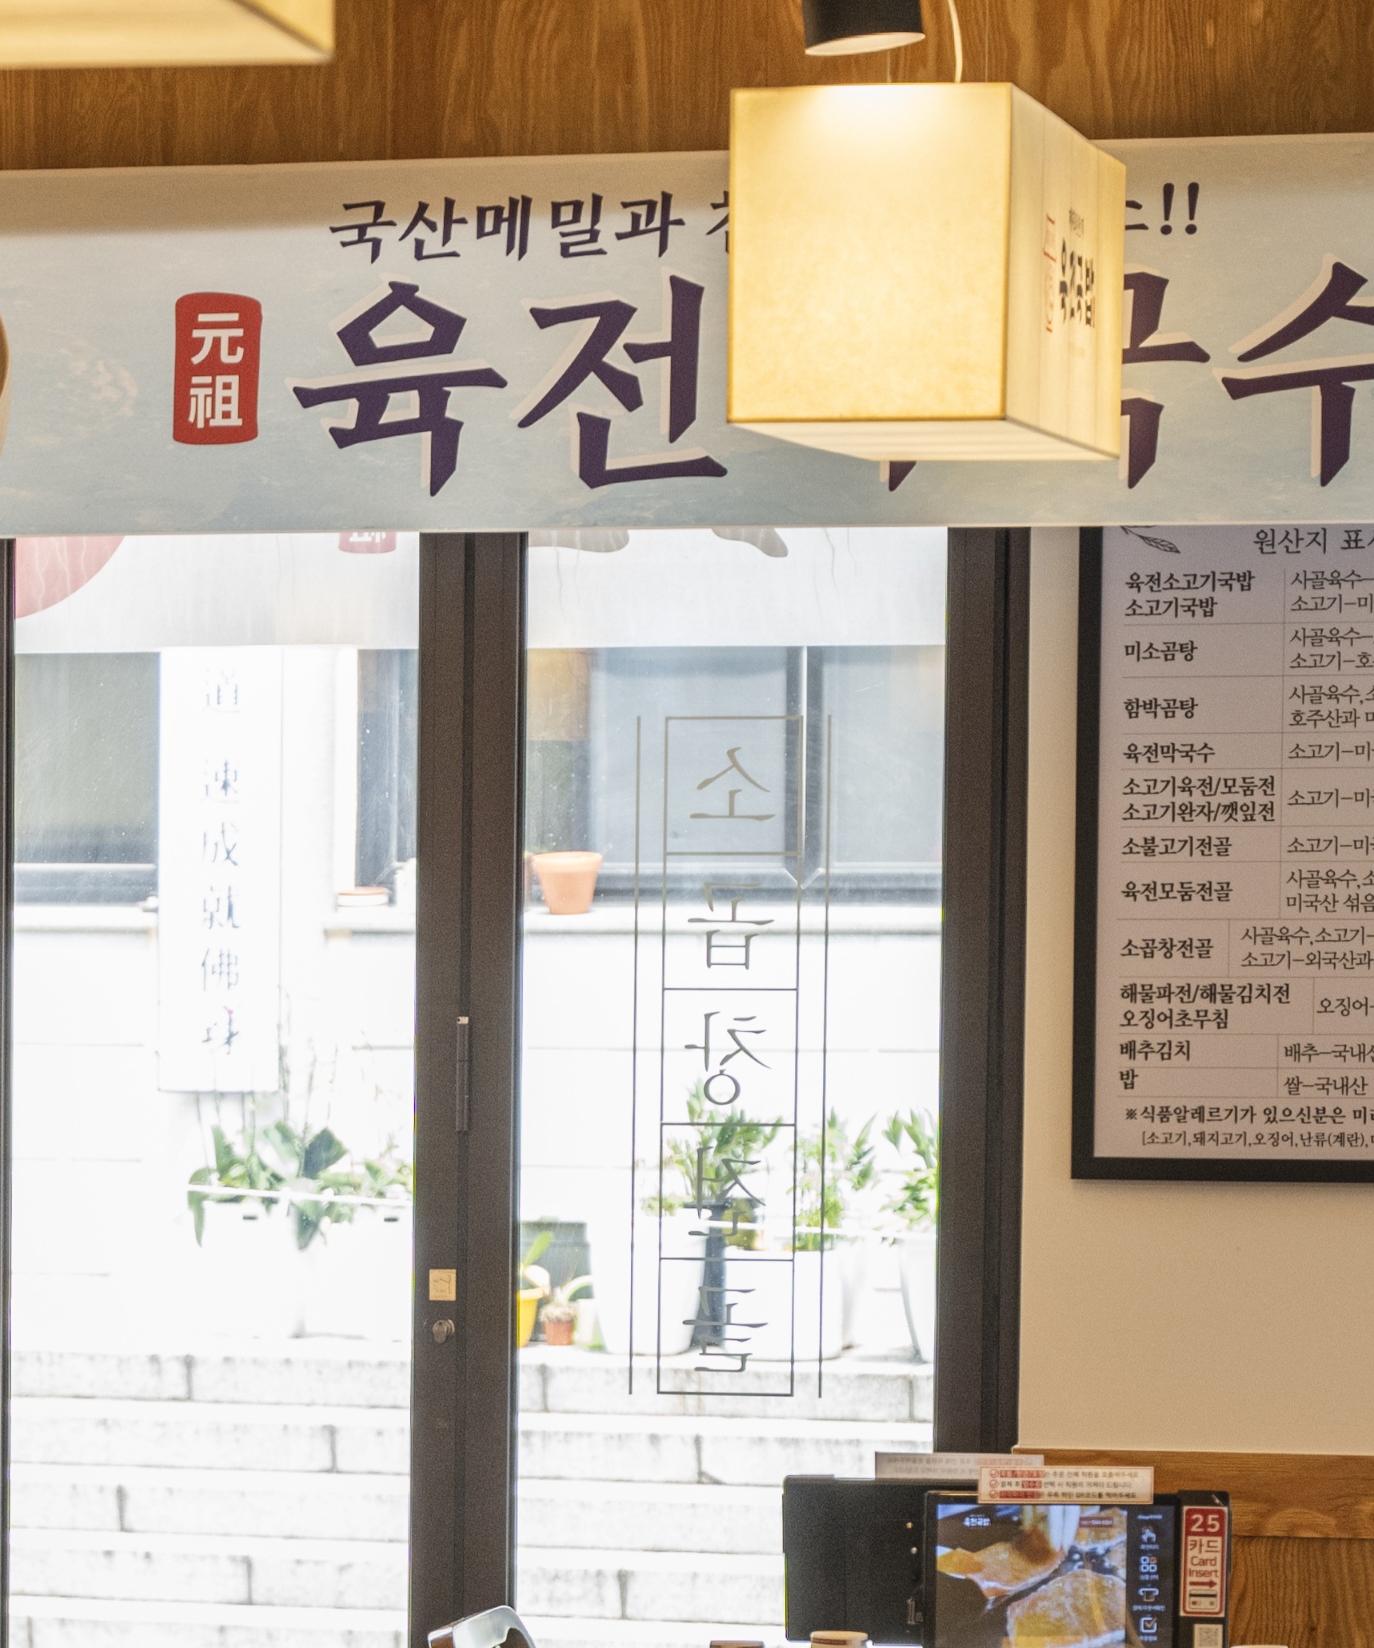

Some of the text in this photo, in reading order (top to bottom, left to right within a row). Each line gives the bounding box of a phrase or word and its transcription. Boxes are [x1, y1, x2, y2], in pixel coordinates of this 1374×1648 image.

[330, 190, 685, 264] 국산메밀과
[187, 312, 245, 429] 元祖
[1253, 527, 1374, 555] 원산지 표
[1125, 569, 1256, 594] 육전소고기국밥
[1124, 596, 1218, 618] 소고기국밥
[1289, 627, 1374, 648] 사골육수-
[1124, 640, 1198, 663] 미소곰탕
[1289, 650, 1374, 672] 소고기-호
[1123, 697, 1198, 720] 함박곰탕
[1288, 707, 1361, 729] 호주산과
[1122, 741, 1374, 765] 육전막국수 소고기-미
[1121, 775, 1276, 798] 소고기육전/모둠전
[1287, 788, 1374, 809] 소고기-미
[1121, 800, 1276, 824] 소고기완자/깻잎전
[1121, 835, 1374, 858] 소불고기전골 소고기-미
[1120, 880, 1234, 903] 육전모둠전골
[1286, 892, 1340, 913] 미국산
[1119, 936, 1214, 959] 소곱창전골
[1120, 982, 1292, 1005] 해물파전/해물김치전
[1119, 1008, 1230, 1030] 오징어초무침
[1119, 1039, 1191, 1062] 배추김치
[1119, 1067, 1139, 1091] 밥
[1262, 1105, 1347, 1125] 있으신분은
[1190, 1513, 1221, 1533] 25
[1189, 1538, 1220, 1555] 카드
[1188, 1567, 1220, 1578] Insert
[1190, 1555, 1217, 1567] Card
